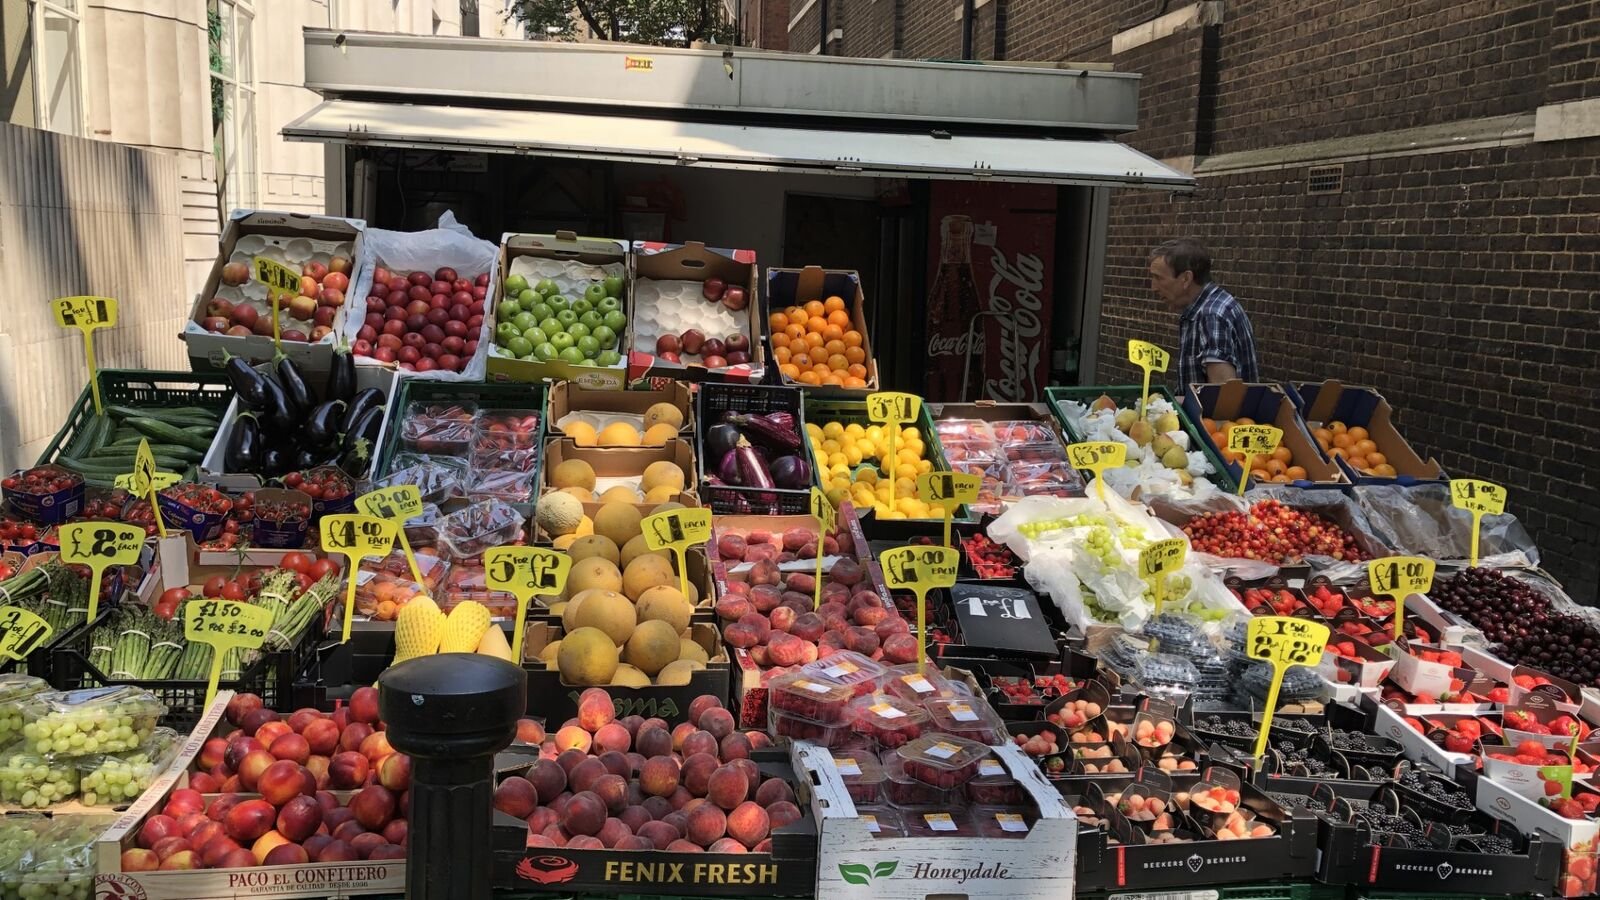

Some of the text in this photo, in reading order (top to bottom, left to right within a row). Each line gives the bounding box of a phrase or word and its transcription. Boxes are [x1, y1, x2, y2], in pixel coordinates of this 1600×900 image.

[61, 301, 77, 325] 2
[85, 299, 108, 325] £1
[873, 397, 888, 418] 3
[894, 396, 912, 420] £1
[929, 475, 955, 500] £1
[365, 490, 418, 518] £2.00 EACH
[328, 520, 390, 548] £4.00 EACH
[652, 514, 706, 546] £1 EACH
[117, 543, 139, 551] EACH
[490, 554, 515, 582] 5
[527, 554, 559, 589] £2
[888, 550, 944, 584] £2.00
[1374, 562, 1429, 592] £4.00 EACH
[999, 598, 1032, 619] £1
[6, 621, 48, 656] £1
[192, 617, 264, 637] 2 FOR £2.00
[1254, 636, 1272, 658] 2
[604, 861, 778, 884] FENIX FRESH
[913, 862, 1009, 884] Honeydale
[1144, 856, 1247, 869] BEEKERS BERRIES
[1396, 864, 1493, 876] BEEKERS BERRIES
[229, 866, 387, 887] PACO EL CONFITERO
